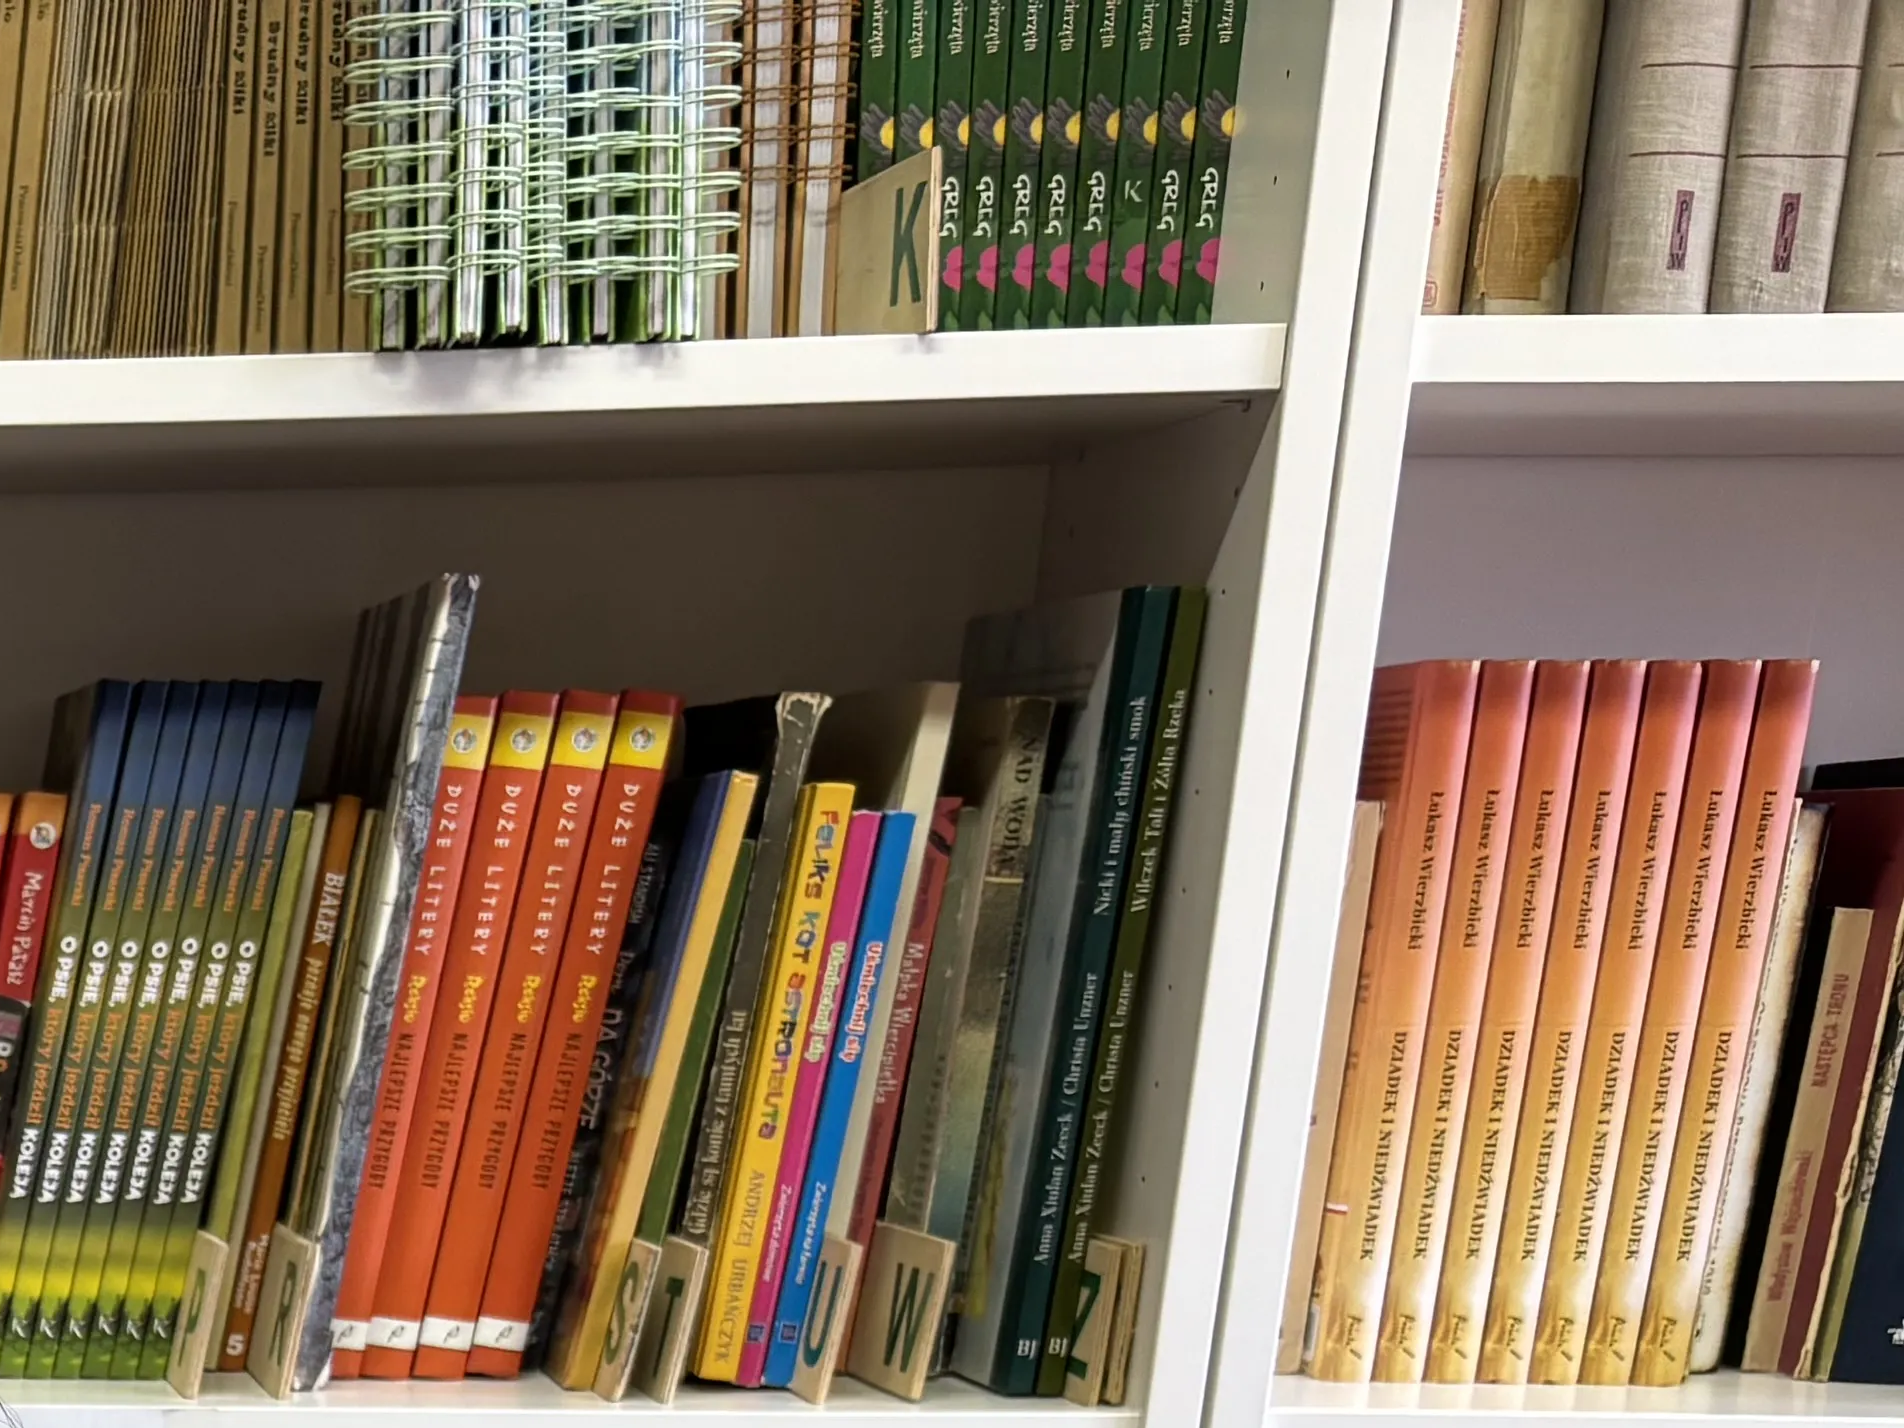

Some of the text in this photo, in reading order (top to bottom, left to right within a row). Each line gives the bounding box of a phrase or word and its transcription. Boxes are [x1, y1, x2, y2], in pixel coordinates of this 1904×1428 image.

[939, 176, 960, 239] GREG
[1044, 173, 1066, 237] GREG
[1195, 166, 1220, 231] GREG
[890, 181, 929, 308] K
[1125, 696, 1147, 736] smok
[585, 782, 641, 957] DUŻE LITERY
[61, 936, 77, 953] O
[571, 975, 599, 1024] Reksio
[839, 941, 883, 1064] Uśmiechnij się
[1072, 971, 1098, 1027] Unzner
[1359, 791, 1446, 1263] Łukasz Wierzbicki DZIADEK NIEDŹWIADEK
[38, 1008, 64, 1064] który
[1062, 1028, 1090, 1098] Christa
[26, 1064, 51, 1126] jeździł
[531, 1033, 583, 1190] NAJLEPSZE PRZYGODY
[732, 1169, 766, 1249] ANDRZEJ
[1034, 1219, 1052, 1266] Anna
[884, 1262, 934, 1374] W
